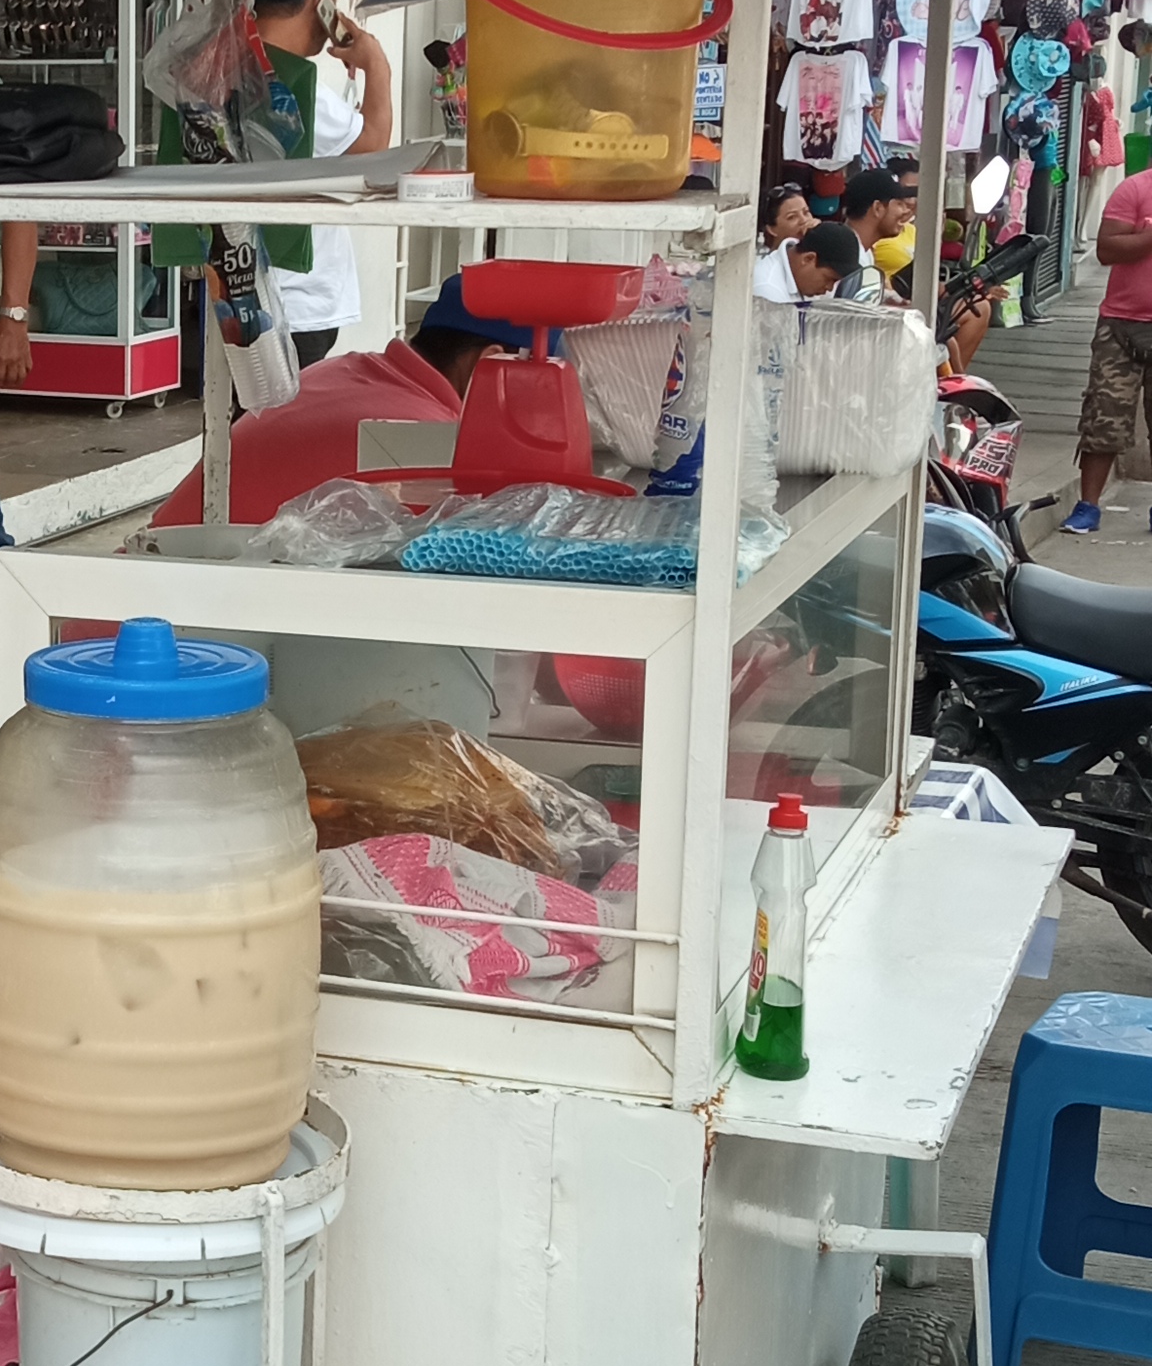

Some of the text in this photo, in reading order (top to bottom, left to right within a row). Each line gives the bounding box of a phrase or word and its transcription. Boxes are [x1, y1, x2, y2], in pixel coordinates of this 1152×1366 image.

[223, 244, 253, 273] 50
[968, 455, 1002, 475] PRO
[1059, 674, 1097, 692] ITALIKA
